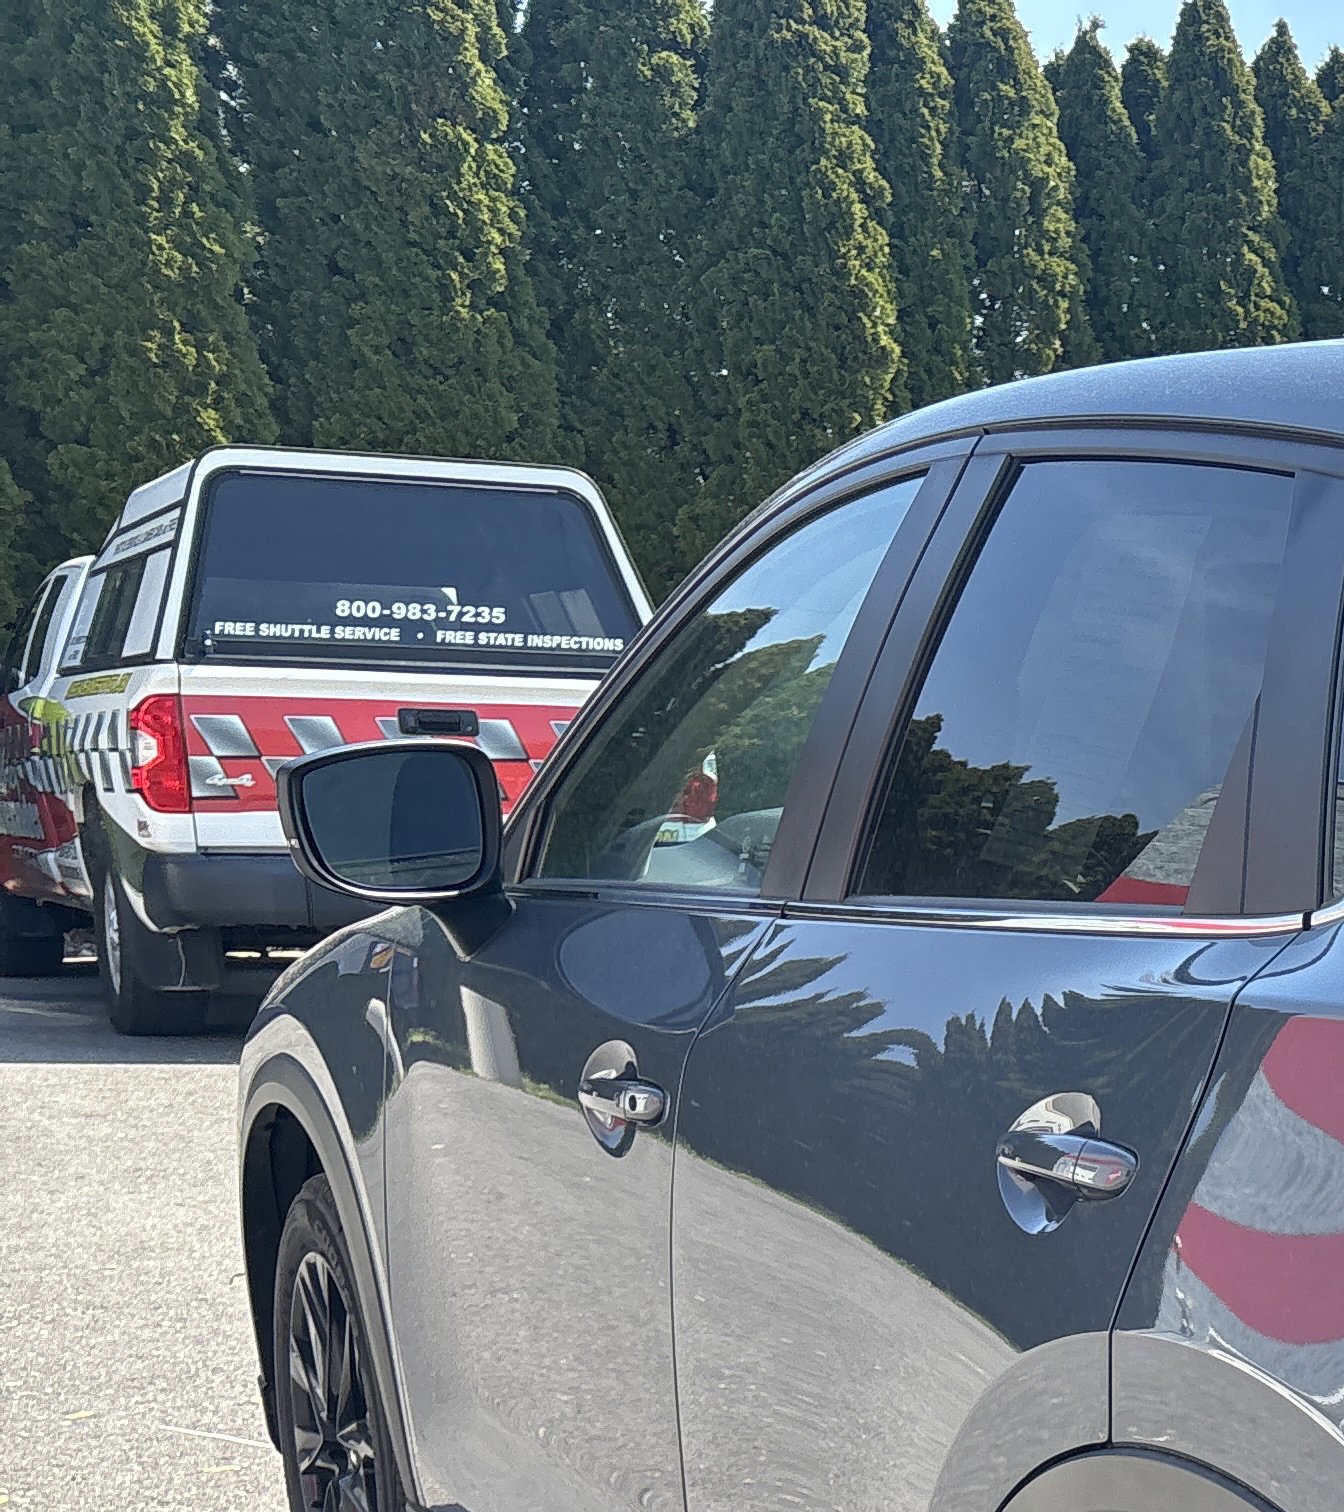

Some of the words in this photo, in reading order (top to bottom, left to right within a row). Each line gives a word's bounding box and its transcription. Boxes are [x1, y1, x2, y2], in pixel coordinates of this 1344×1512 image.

[335, 599, 506, 624] 800-983-7235
[214, 621, 256, 636] FREE
[258, 622, 331, 639] SHUTTLE
[333, 625, 401, 641] SERVICE
[436, 629, 475, 645] FREE
[477, 632, 525, 647] STATE
[526, 634, 624, 651] INSPECTIONS
